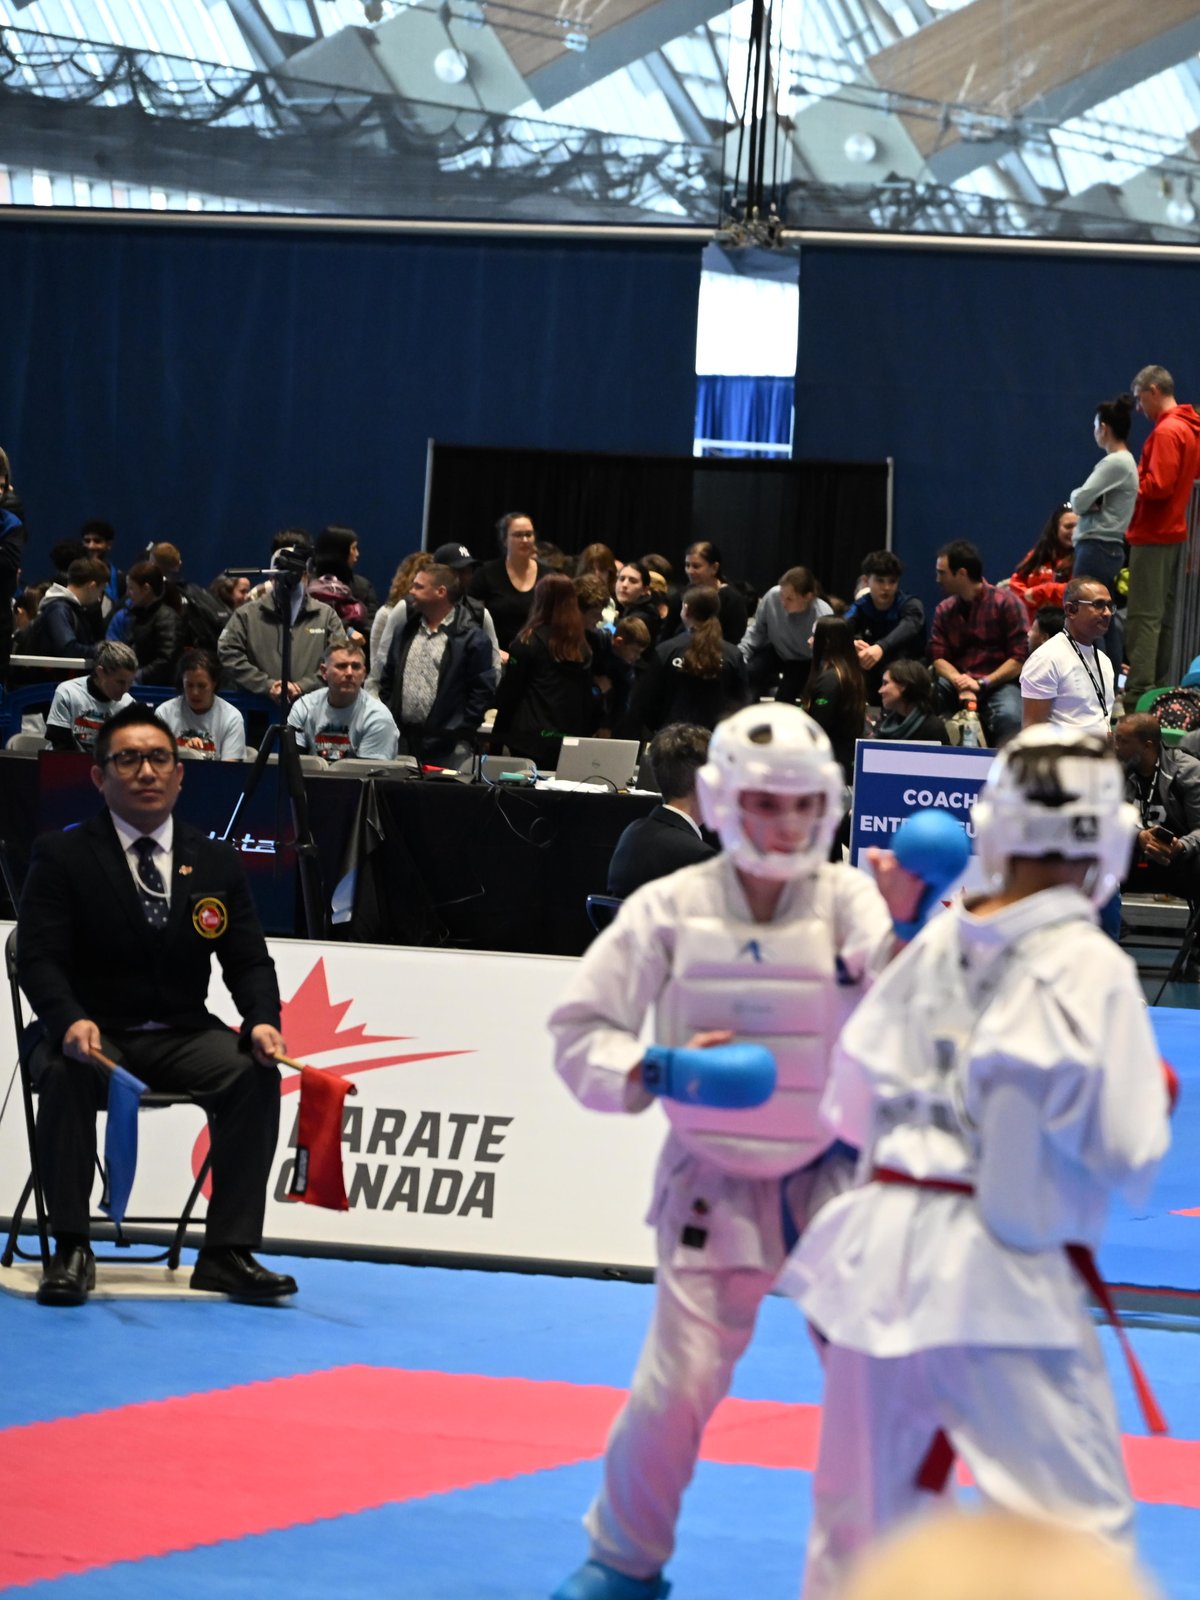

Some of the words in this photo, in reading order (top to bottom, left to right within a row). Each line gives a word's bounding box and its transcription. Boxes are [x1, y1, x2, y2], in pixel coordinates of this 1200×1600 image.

[903, 788, 979, 809] COACH
[288, 1101, 515, 1163] ARATE
[273, 1157, 496, 1219] CNADA
